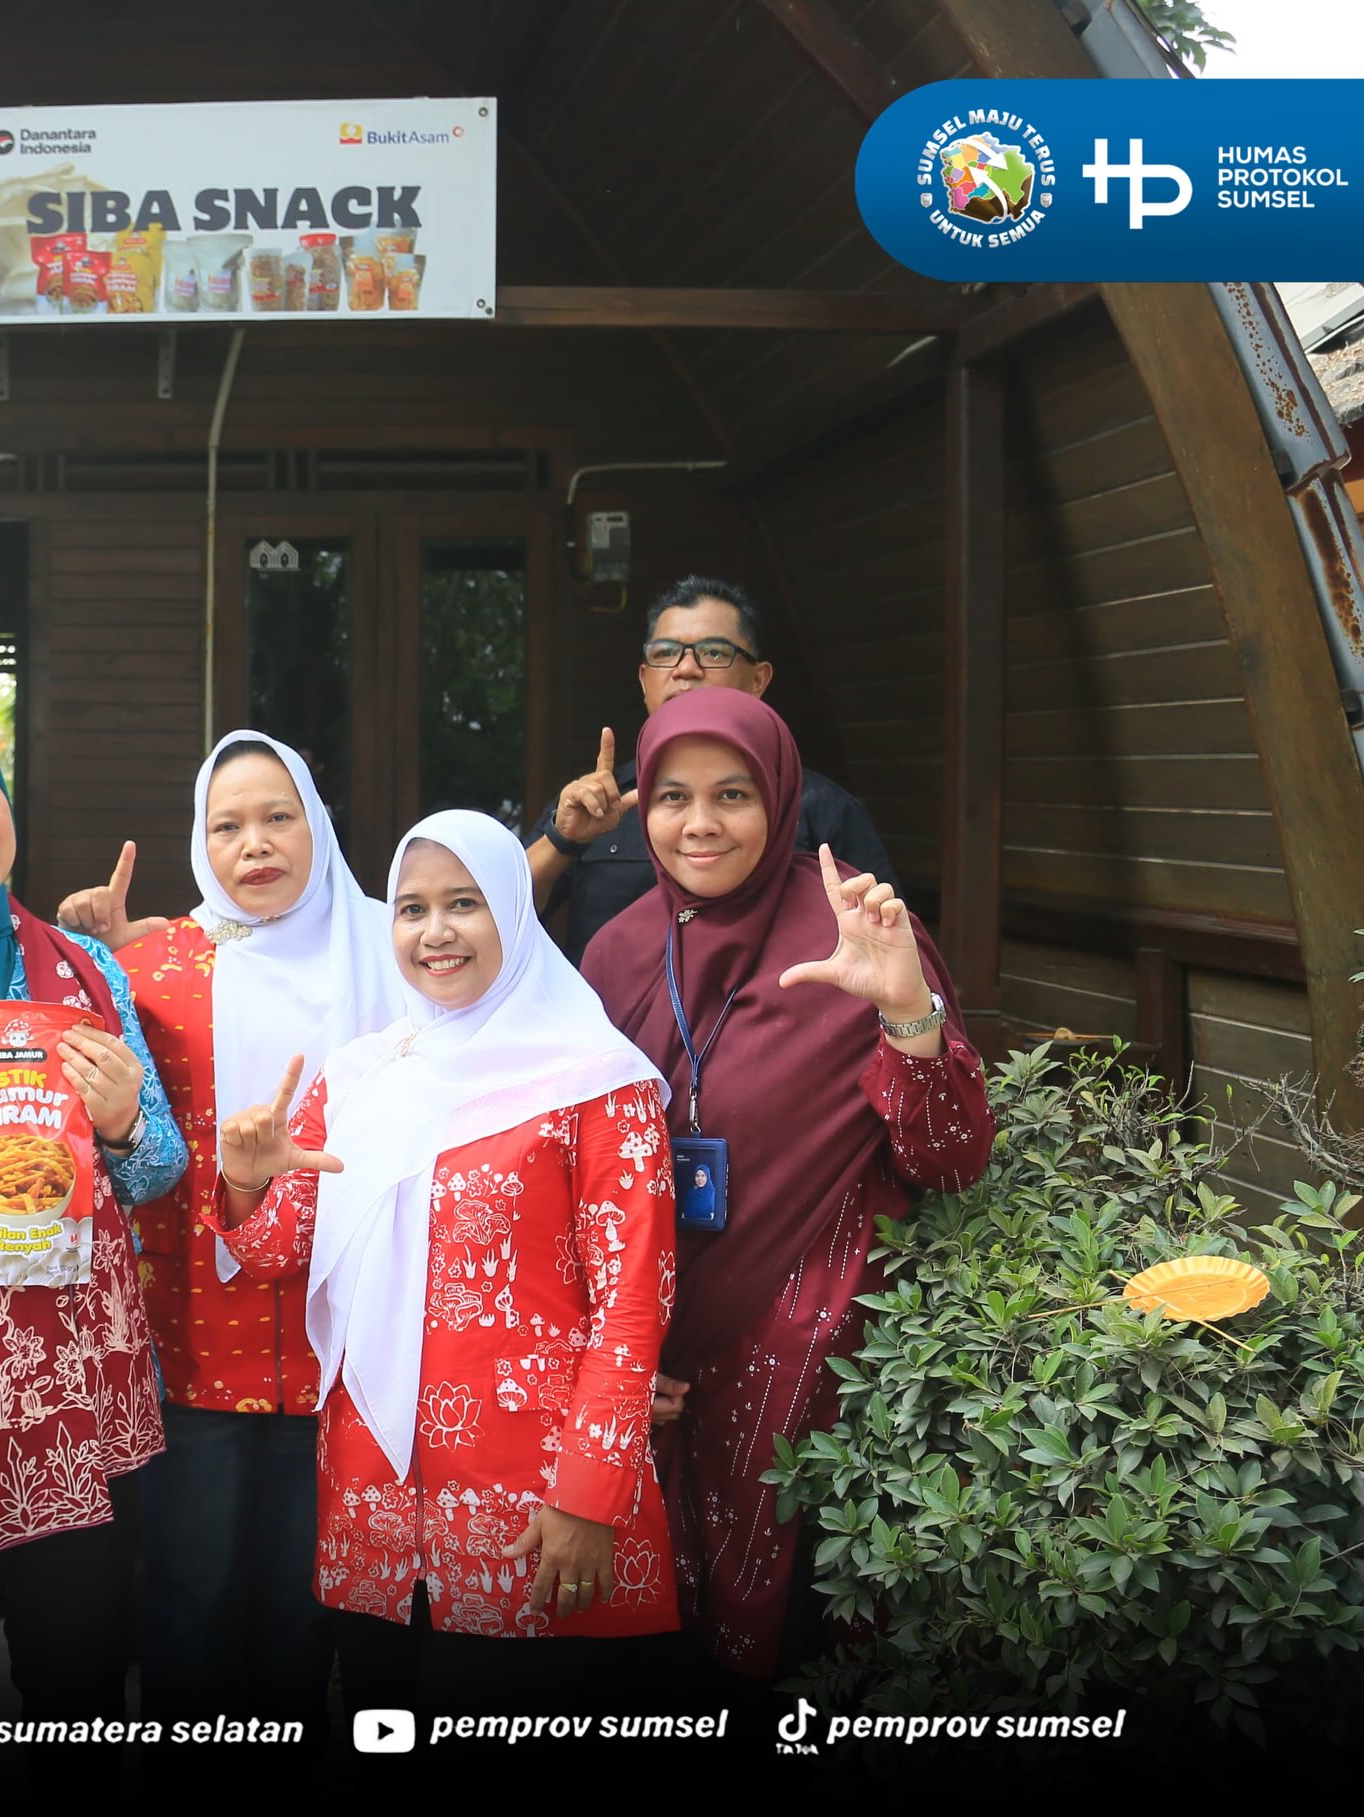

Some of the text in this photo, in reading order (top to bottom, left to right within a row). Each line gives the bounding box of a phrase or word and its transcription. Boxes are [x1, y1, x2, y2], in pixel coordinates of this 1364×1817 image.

[20, 129, 96, 141] Danantara
[20, 142, 92, 154] Indonesia
[27, 186, 423, 234] SIBA SNACK
[14, 1050, 44, 1060] JAMUR
[29, 1223, 62, 1239] Enak
